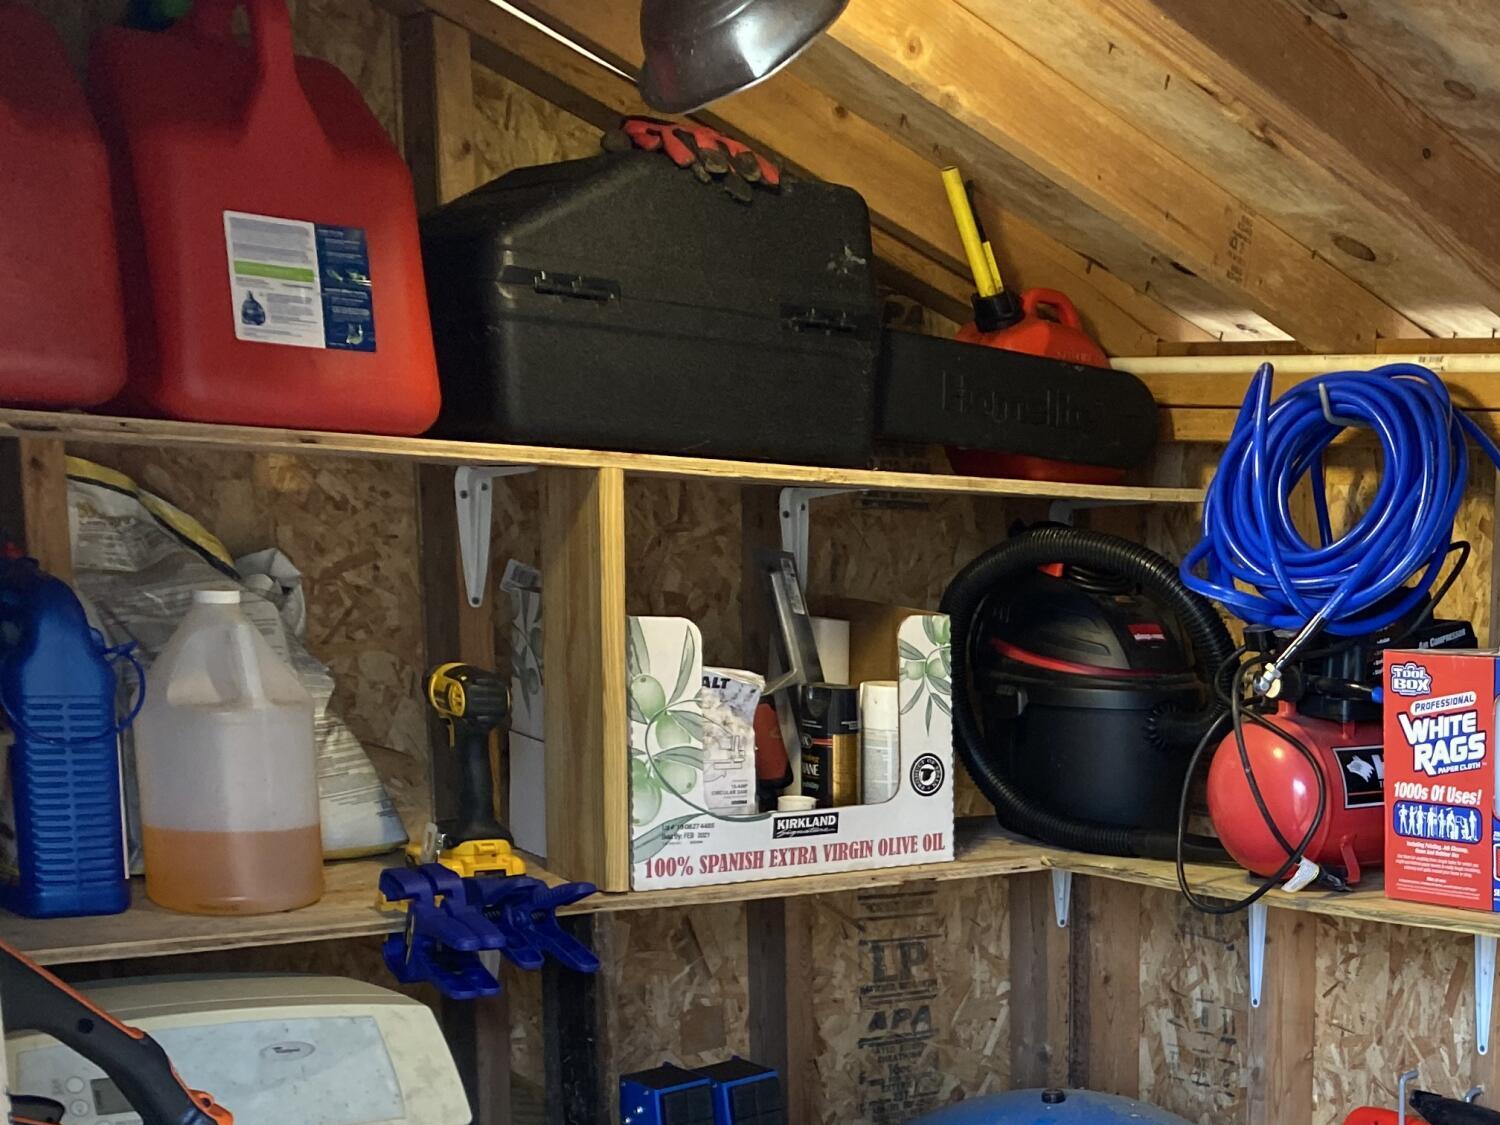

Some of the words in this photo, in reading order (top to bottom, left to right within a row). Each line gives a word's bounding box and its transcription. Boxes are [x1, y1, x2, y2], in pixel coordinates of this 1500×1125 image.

[1392, 667, 1426, 679] TOOL
[1393, 678, 1430, 692] BOX
[1415, 694, 1475, 712] PROFESSIONAL
[1398, 711, 1477, 745] WHITE
[1414, 732, 1486, 775] RAGS
[1438, 765, 1460, 774] PAPER
[1460, 762, 1481, 770] CLOTH
[1394, 781, 1429, 800] 1000s
[1431, 784, 1445, 801] Of
[1446, 787, 1482, 805] Uses!
[777, 815, 837, 830] KIRKLAND
[645, 856, 693, 878] 100%
[699, 850, 764, 874] SPANISH
[769, 846, 818, 868] EXTRA
[823, 840, 873, 862] VIRGIN
[877, 835, 918, 857] OLIVE
[922, 832, 945, 852] OIL
[868, 1005, 932, 1033] APA
